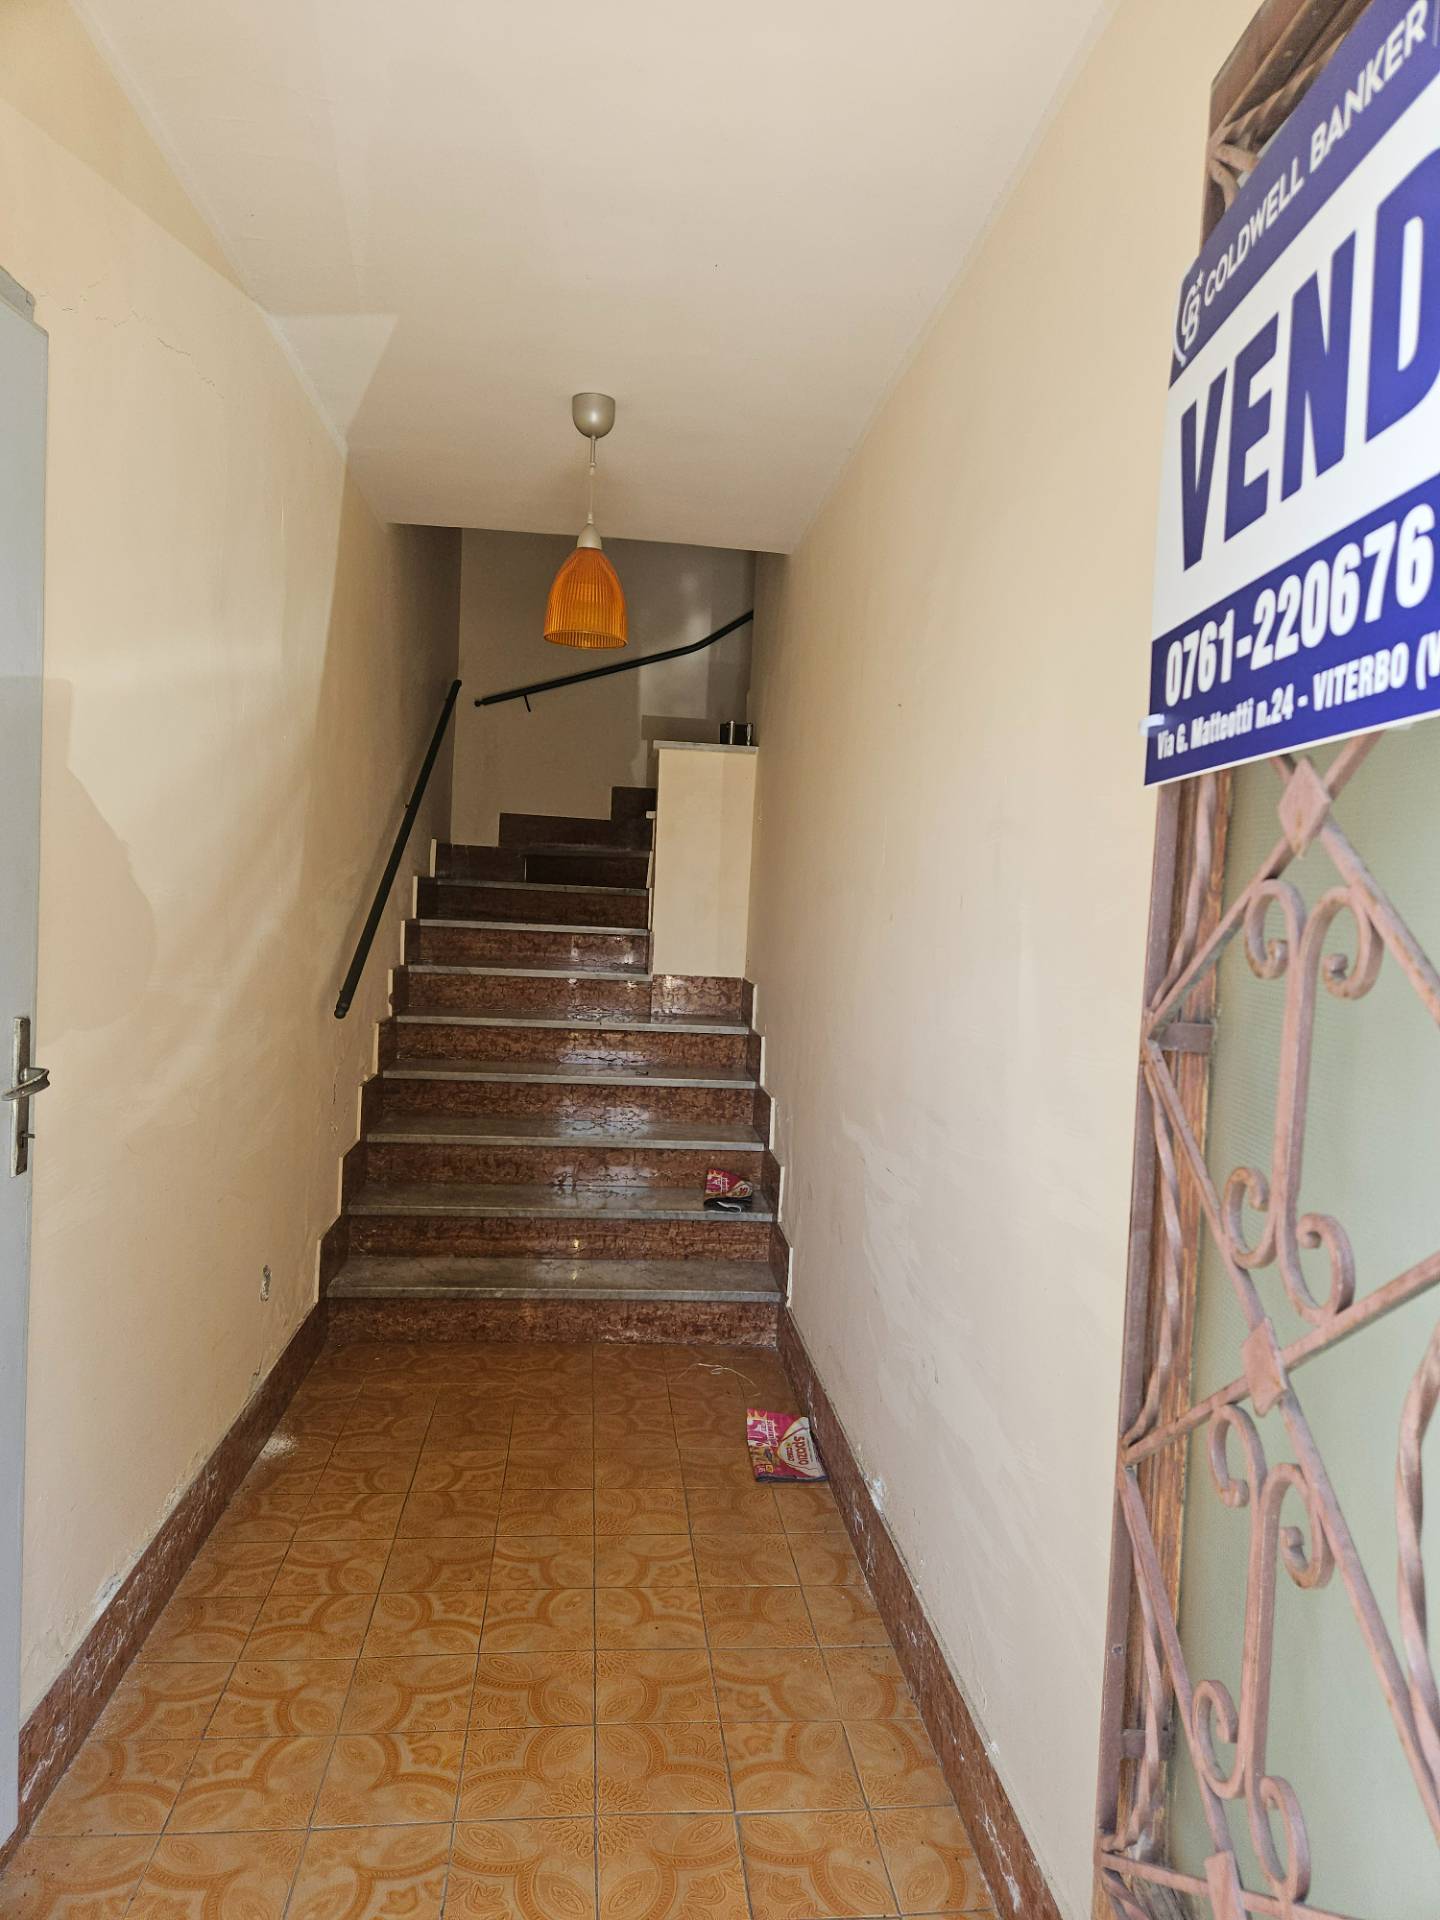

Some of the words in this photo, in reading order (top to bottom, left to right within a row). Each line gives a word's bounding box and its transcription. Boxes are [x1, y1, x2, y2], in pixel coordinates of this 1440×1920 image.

[1203, 155, 1304, 307] COLDWELL
[1309, 0, 1428, 174] BANKER
[1180, 146, 1440, 573] VEND
[1157, 729, 1175, 760] Via
[1190, 697, 1255, 750] Matteotti
[1312, 641, 1410, 712] VITERBO
[1164, 503, 1435, 707] 0761-220676
